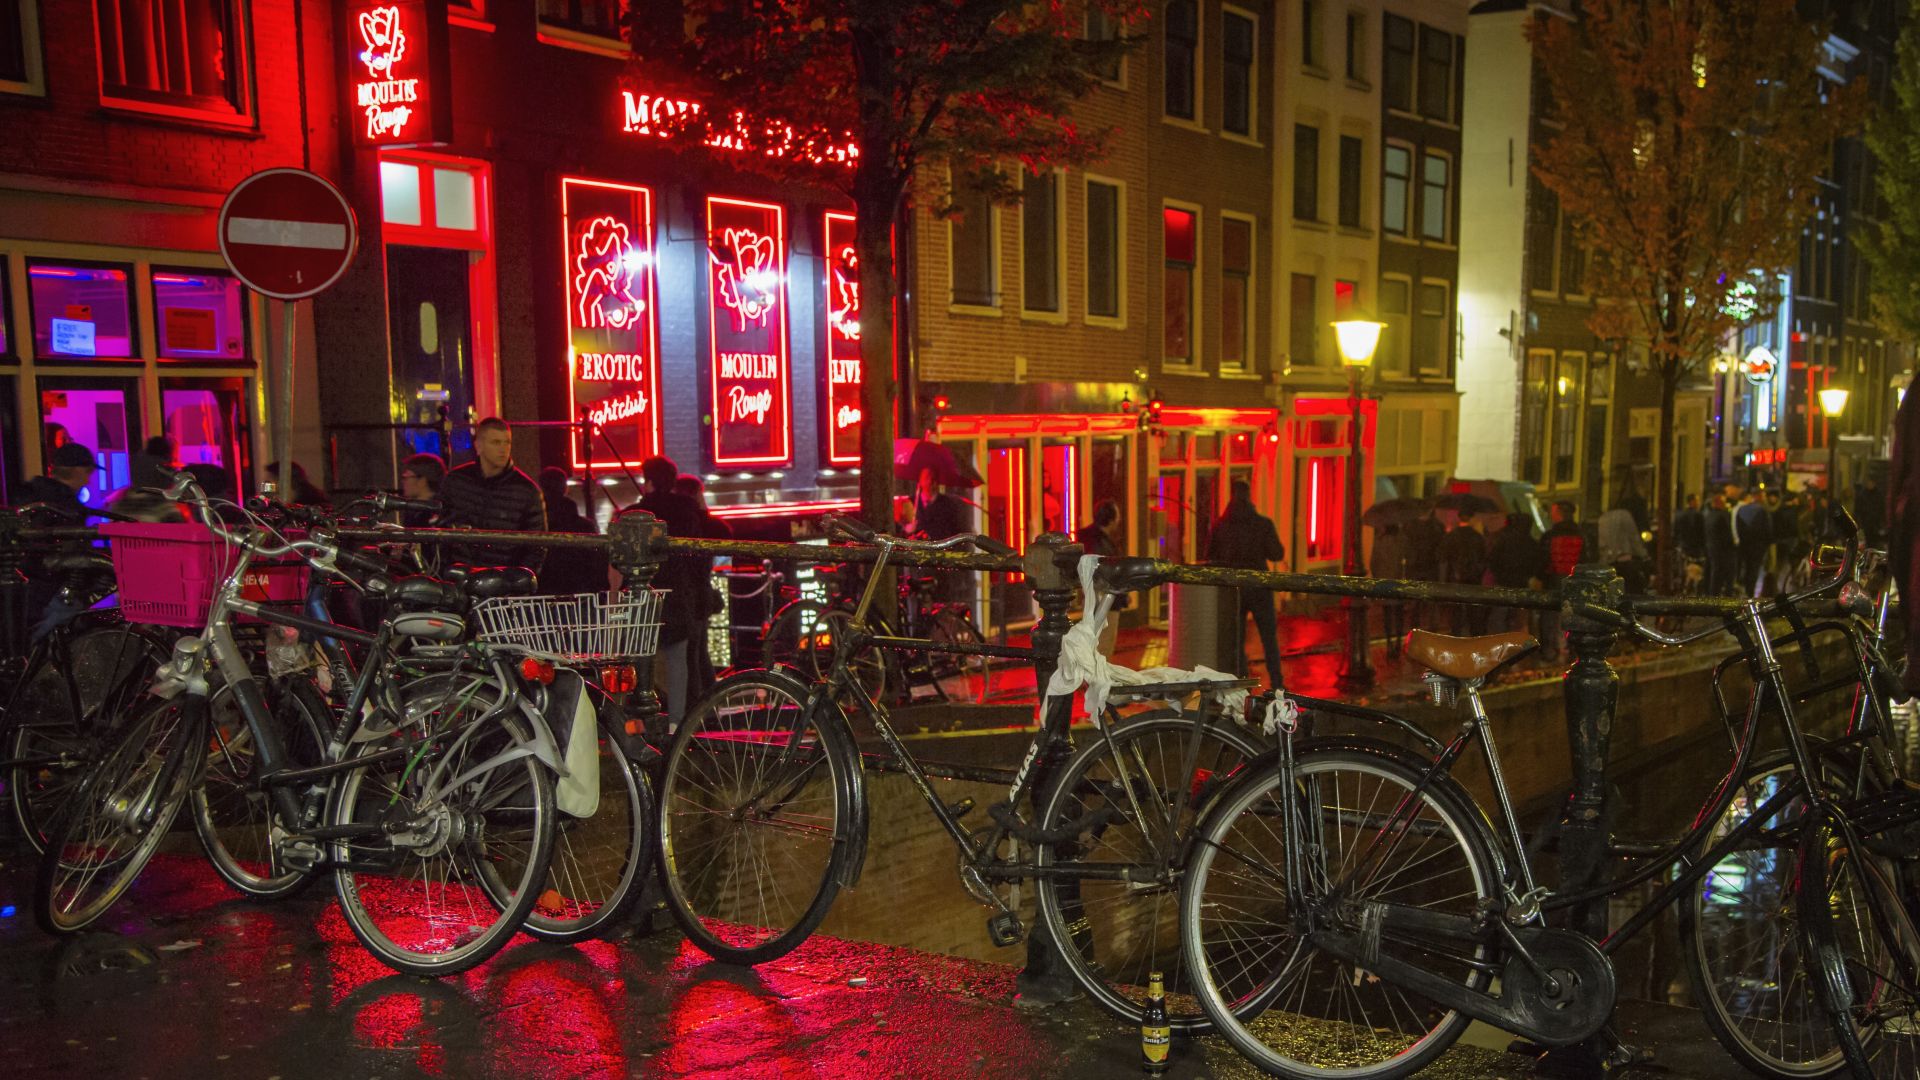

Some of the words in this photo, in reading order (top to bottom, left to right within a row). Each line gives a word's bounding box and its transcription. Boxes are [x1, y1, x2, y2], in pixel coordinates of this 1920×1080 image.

[357, 79, 418, 106] MOULIN
[365, 105, 412, 139] Rouge
[581, 352, 643, 382] EROTIC
[720, 353, 777, 379] MOULIN
[728, 385, 772, 425] Rouge
[242, 573, 270, 586] HEMA
[1009, 743, 1039, 803] ATLAS
